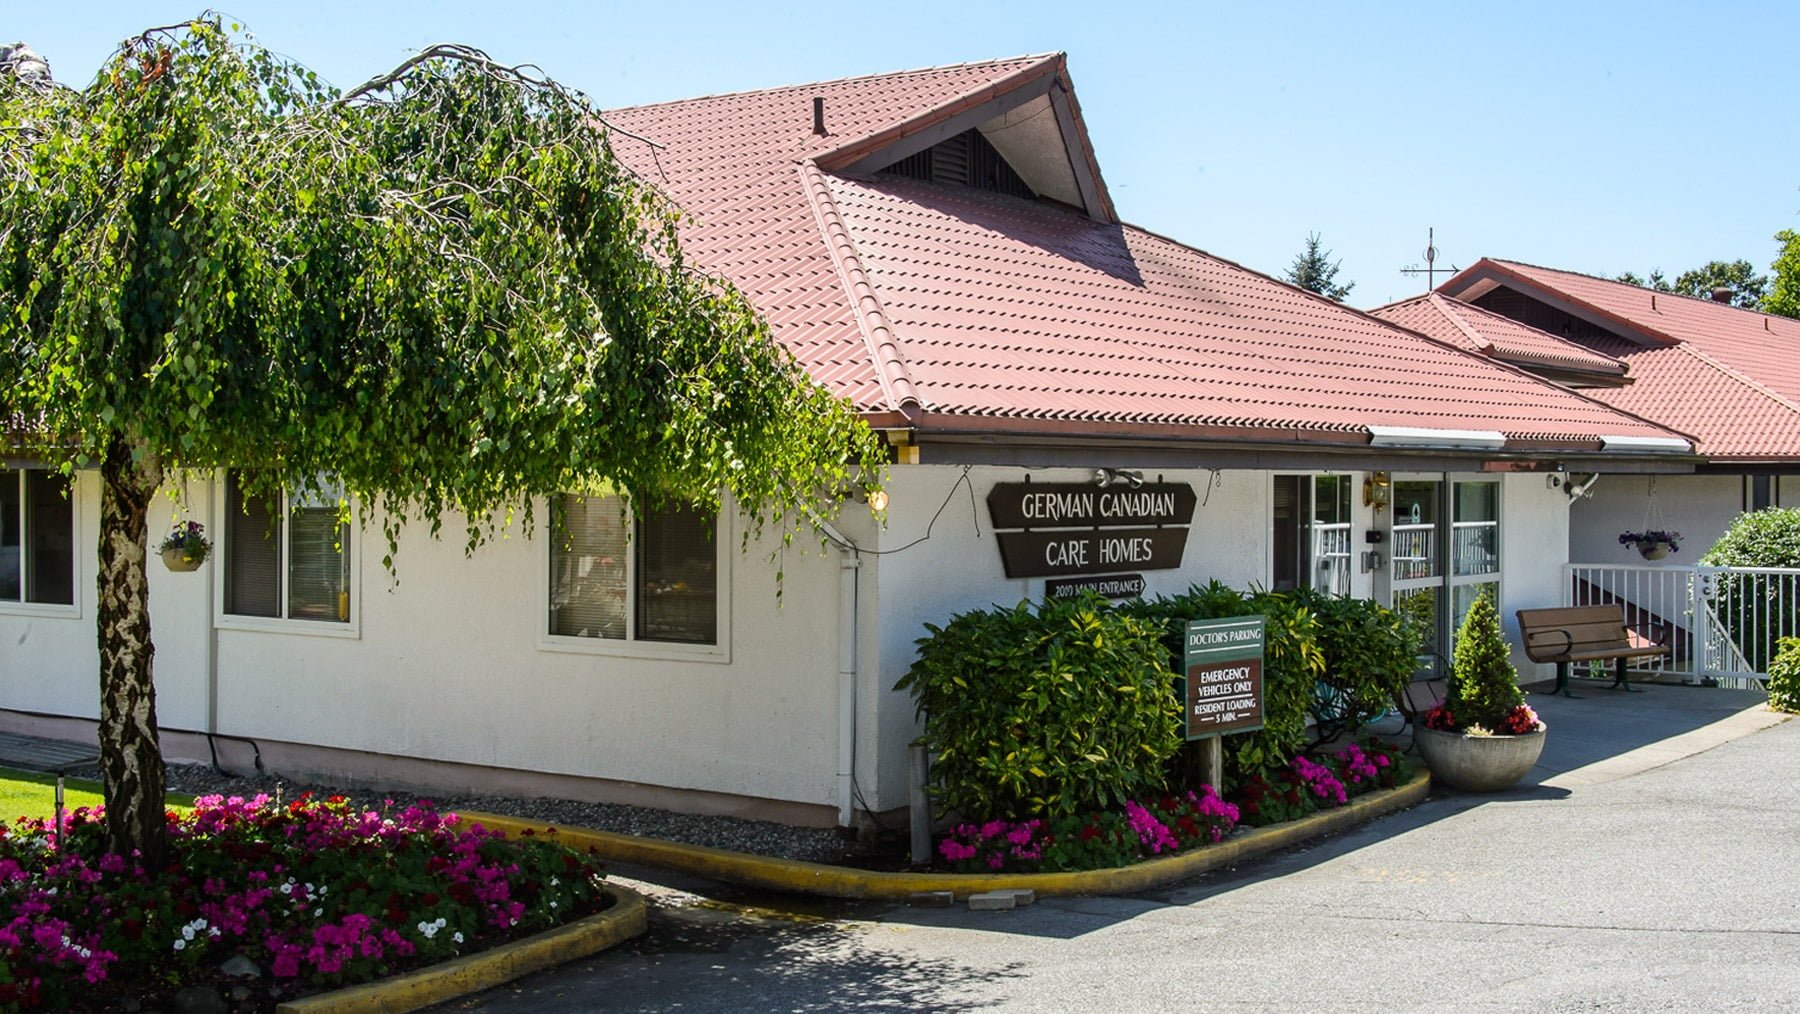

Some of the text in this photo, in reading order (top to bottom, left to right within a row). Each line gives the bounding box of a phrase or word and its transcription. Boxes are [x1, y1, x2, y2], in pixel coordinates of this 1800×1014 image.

[1022, 493, 1174, 520] GERMAN CANADIAN
[1046, 538, 1153, 567] CARE HOMES
[1100, 580, 1139, 597] ENTRANCE
[1230, 628, 1261, 642] PARKING
[1201, 667, 1250, 683] EMERGENCY
[1199, 681, 1252, 696] VEHICLES ONLY
[1195, 698, 1256, 715] RESIDENT LOADING
[1216, 714, 1220, 723] 5
